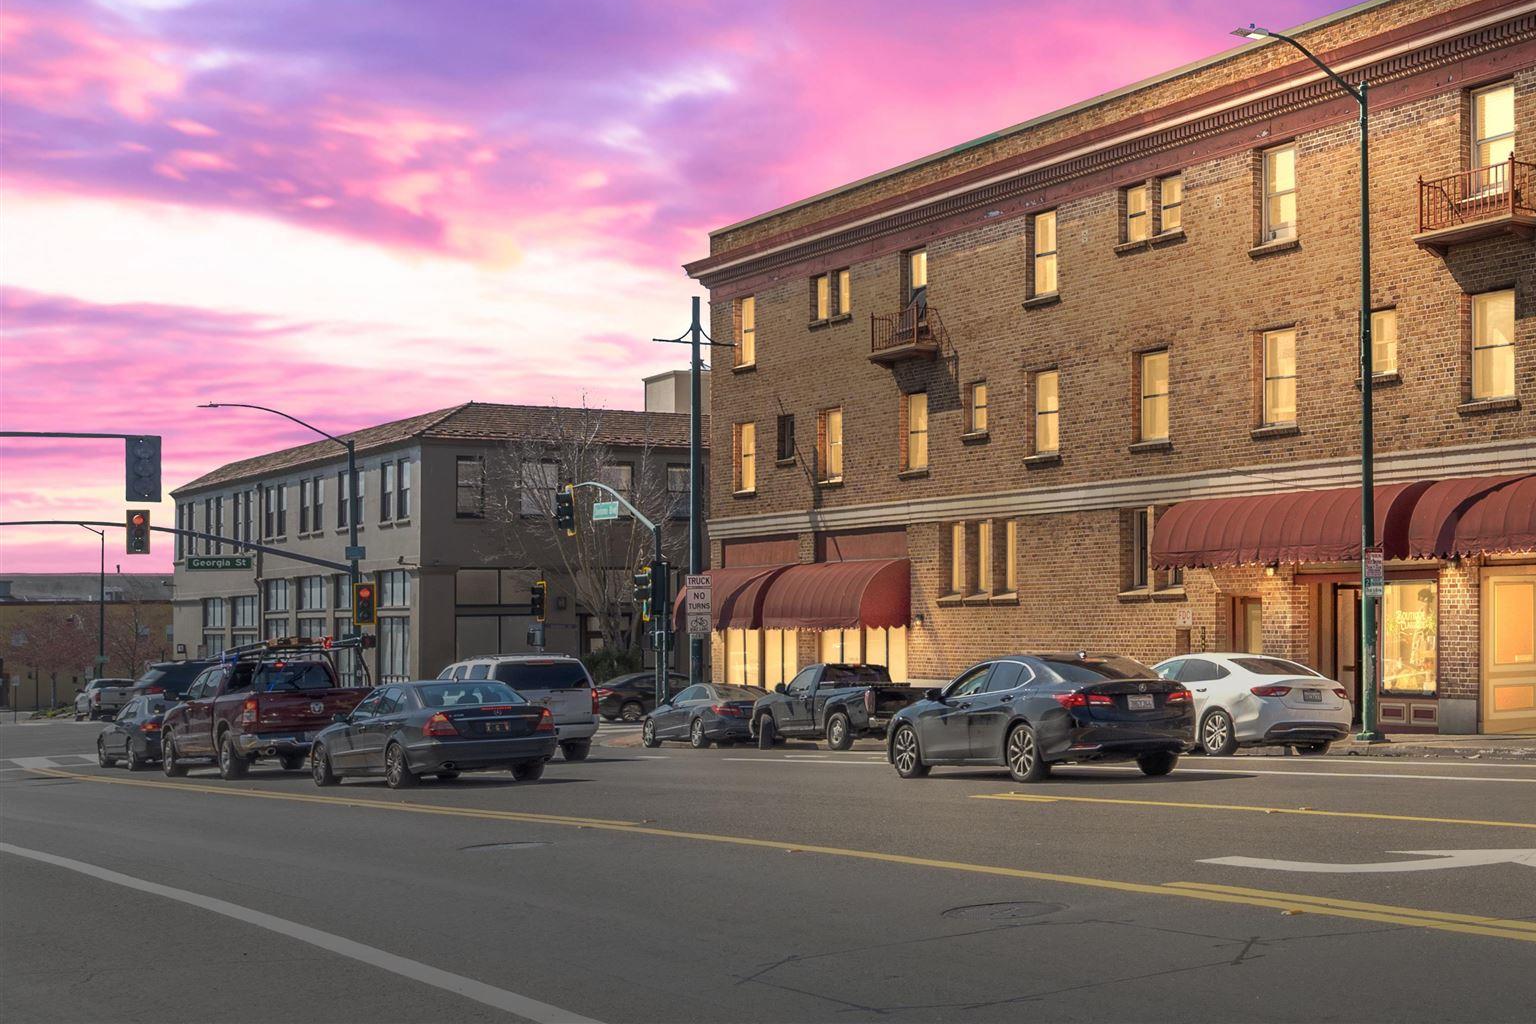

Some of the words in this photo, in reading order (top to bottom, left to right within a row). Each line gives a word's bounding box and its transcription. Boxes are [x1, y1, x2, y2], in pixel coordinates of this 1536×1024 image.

[192, 558, 231, 568] Georgia
[235, 558, 247, 566] St
[687, 577, 711, 585] TRUCK
[693, 592, 706, 600] NO
[688, 602, 711, 610] TURNS
